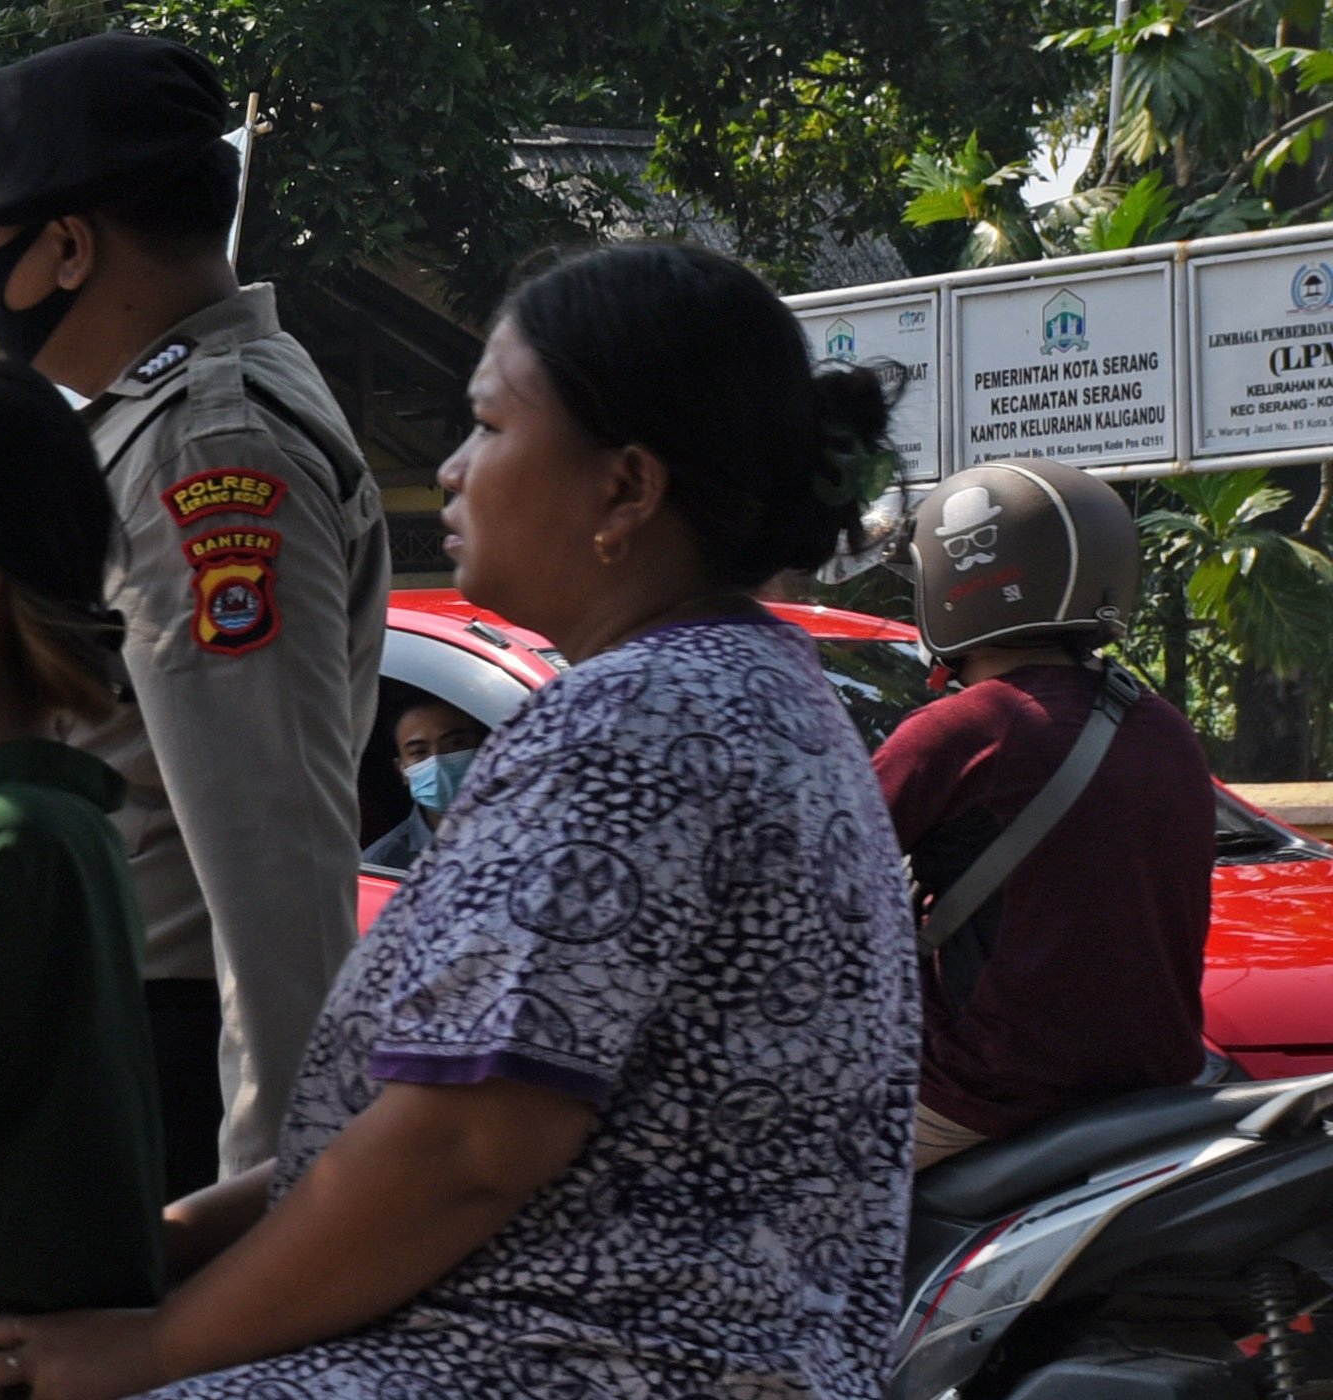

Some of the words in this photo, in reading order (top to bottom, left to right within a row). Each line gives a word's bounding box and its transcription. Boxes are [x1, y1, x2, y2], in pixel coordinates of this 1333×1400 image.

[1208, 330, 1259, 349] LEMBAGA
[974, 364, 1059, 391] PEMERINTAH
[1062, 359, 1099, 381] KOTA
[1102, 352, 1159, 376] SERANG
[1246, 378, 1315, 398] KELURAHAN
[1317, 376, 1333, 390] KA
[990, 389, 1078, 416] KECAMATAN
[1082, 381, 1143, 406] SERANG
[1230, 403, 1255, 417] KEC
[1258, 397, 1308, 414] SERANG
[970, 421, 1017, 444] KANTOR
[1020, 412, 1092, 438] KELURAHAN
[1095, 405, 1166, 430] KALIGANDU
[1306, 417, 1328, 429] Kota
[1057, 444, 1076, 456] Kota
[1141, 435, 1165, 447] 42151
[174, 475, 273, 502] POLRES
[192, 533, 272, 556] BANTEN
